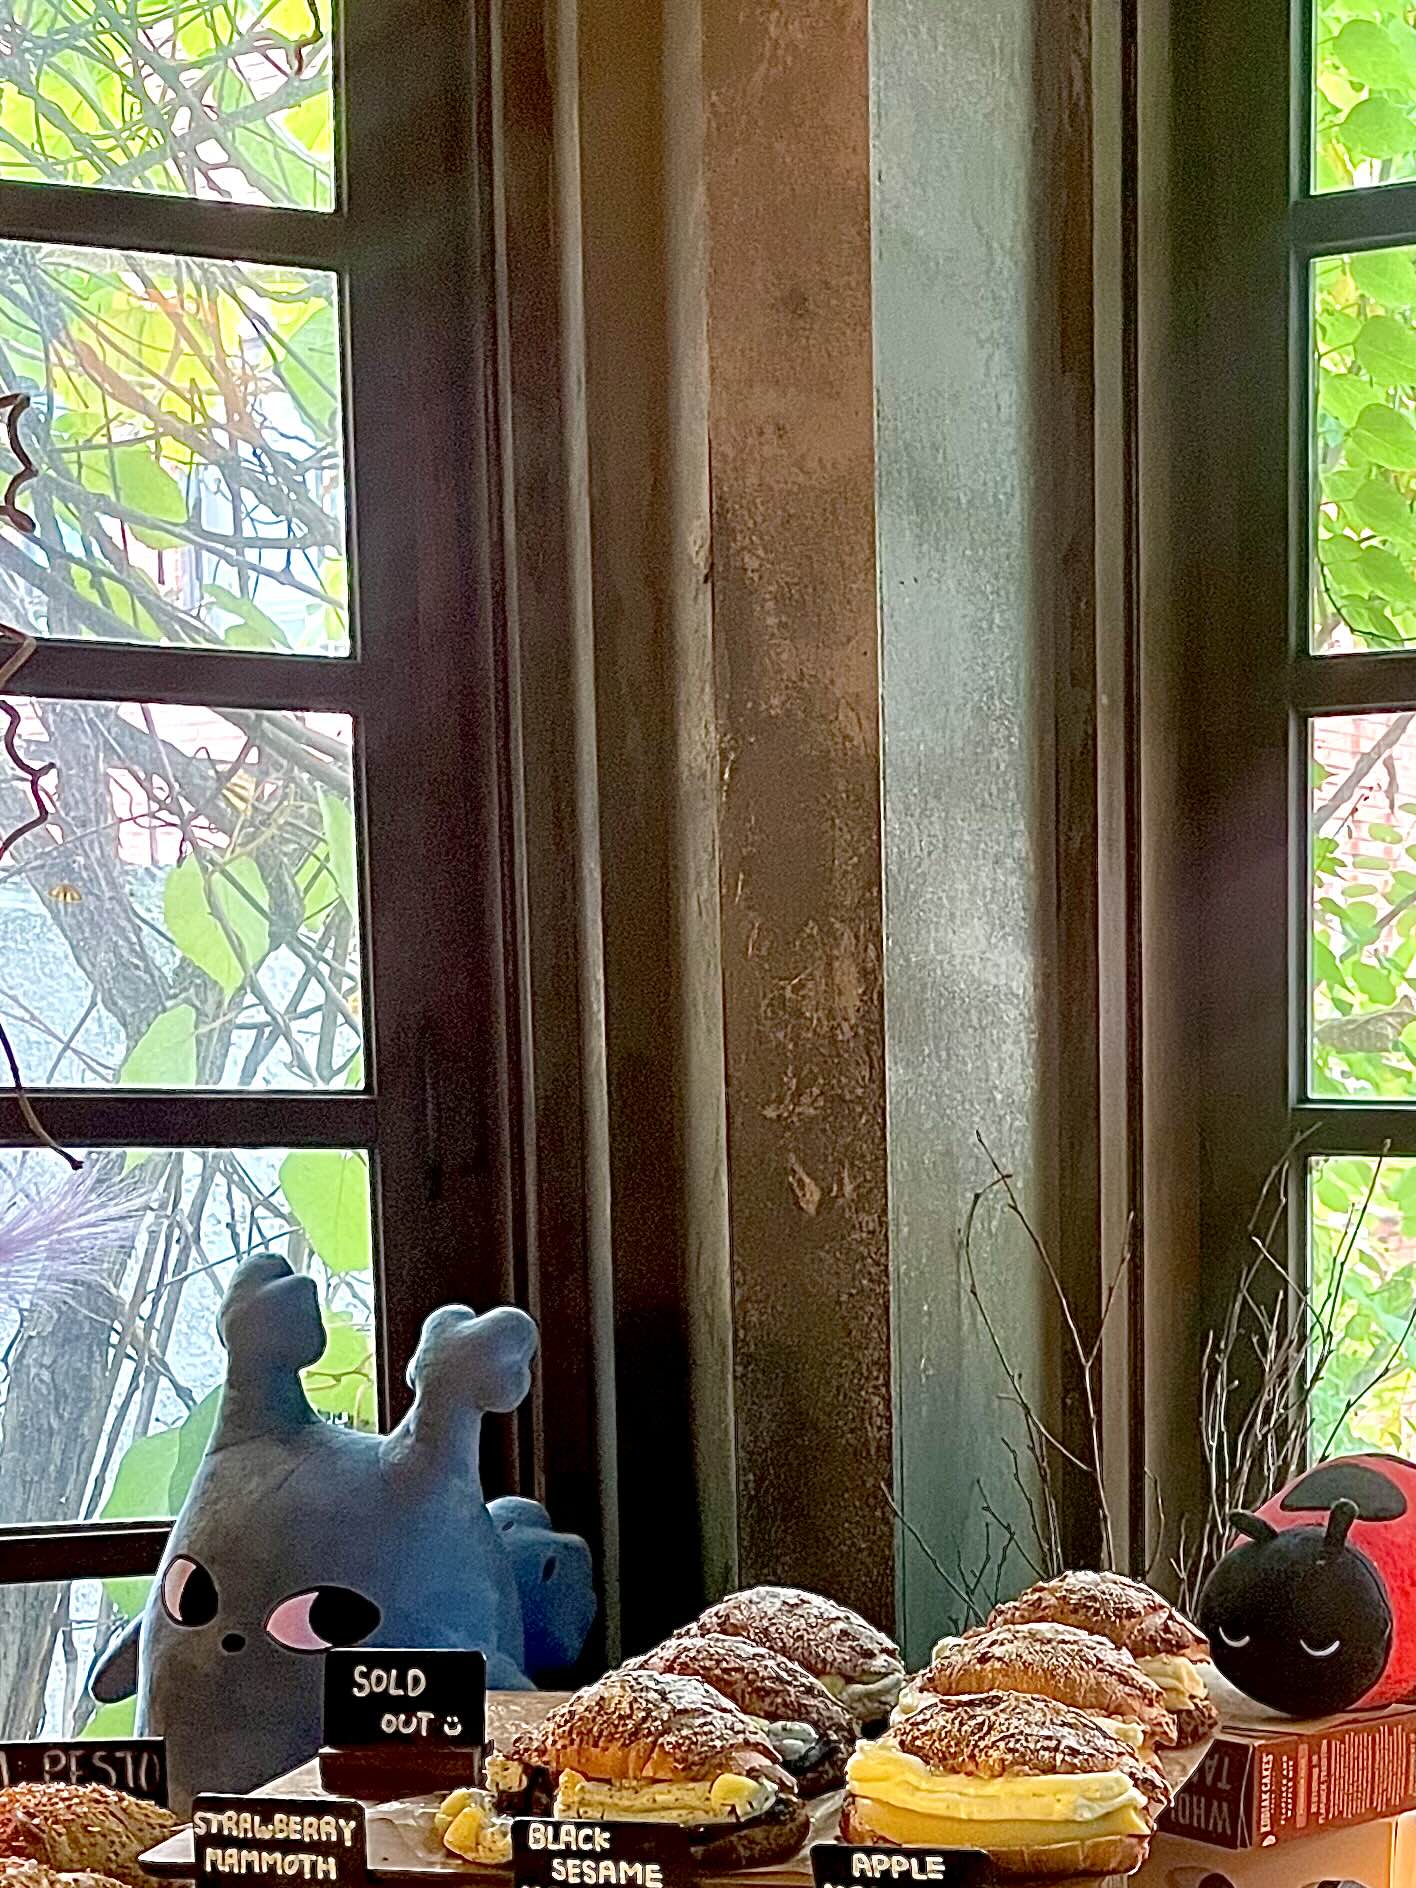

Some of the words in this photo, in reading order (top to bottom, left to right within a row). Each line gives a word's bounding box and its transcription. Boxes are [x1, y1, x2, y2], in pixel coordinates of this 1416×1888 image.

[352, 1665, 426, 1698] SOLD
[381, 1712, 434, 1735] OUT
[43, 1749, 160, 1791] PESTO
[1262, 1753, 1273, 1791] CAKES
[528, 1823, 611, 1852] BLACK
[205, 1847, 337, 1880] MAMMOTH
[551, 1858, 663, 1888] SESAME
[852, 1853, 946, 1881] APPLE
